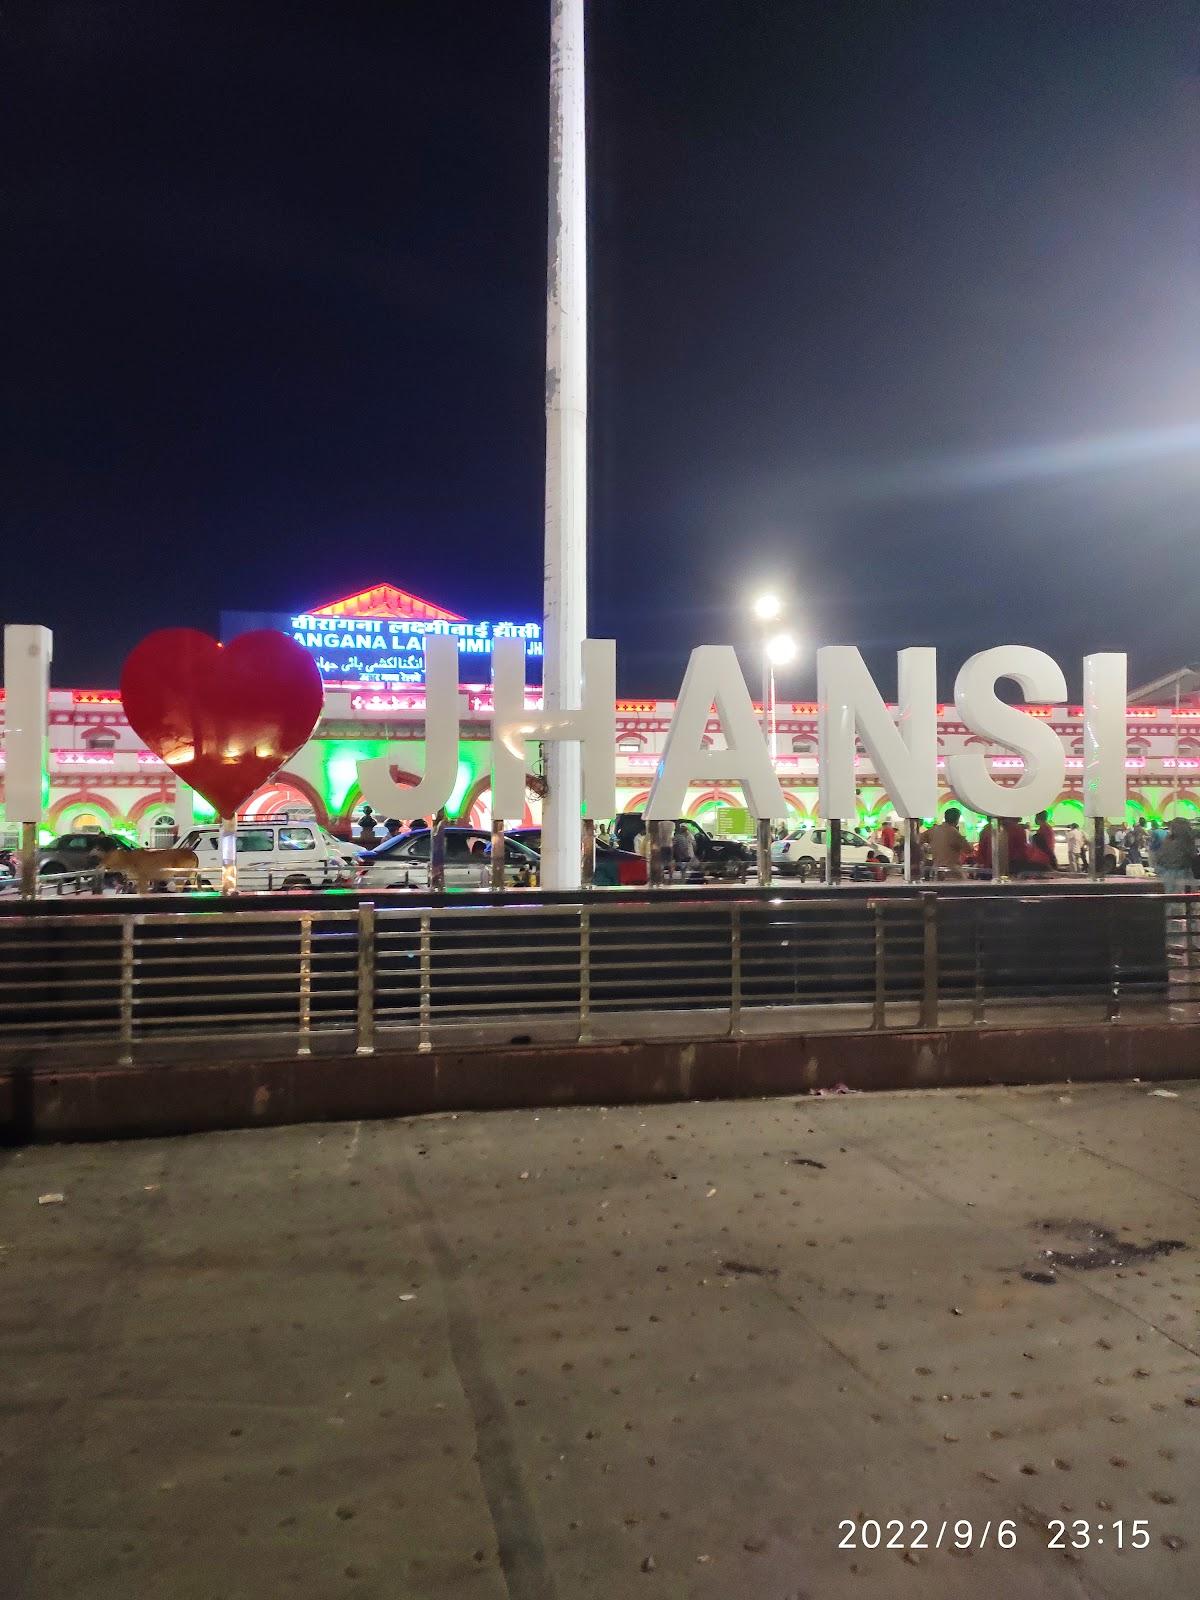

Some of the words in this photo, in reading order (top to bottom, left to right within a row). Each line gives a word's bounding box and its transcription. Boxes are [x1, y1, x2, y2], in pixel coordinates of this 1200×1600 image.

[291, 614, 384, 633] वीरांगना
[284, 632, 388, 650] ANGANA
[4, 624, 52, 823] I
[356, 635, 1128, 821] JHANSI
